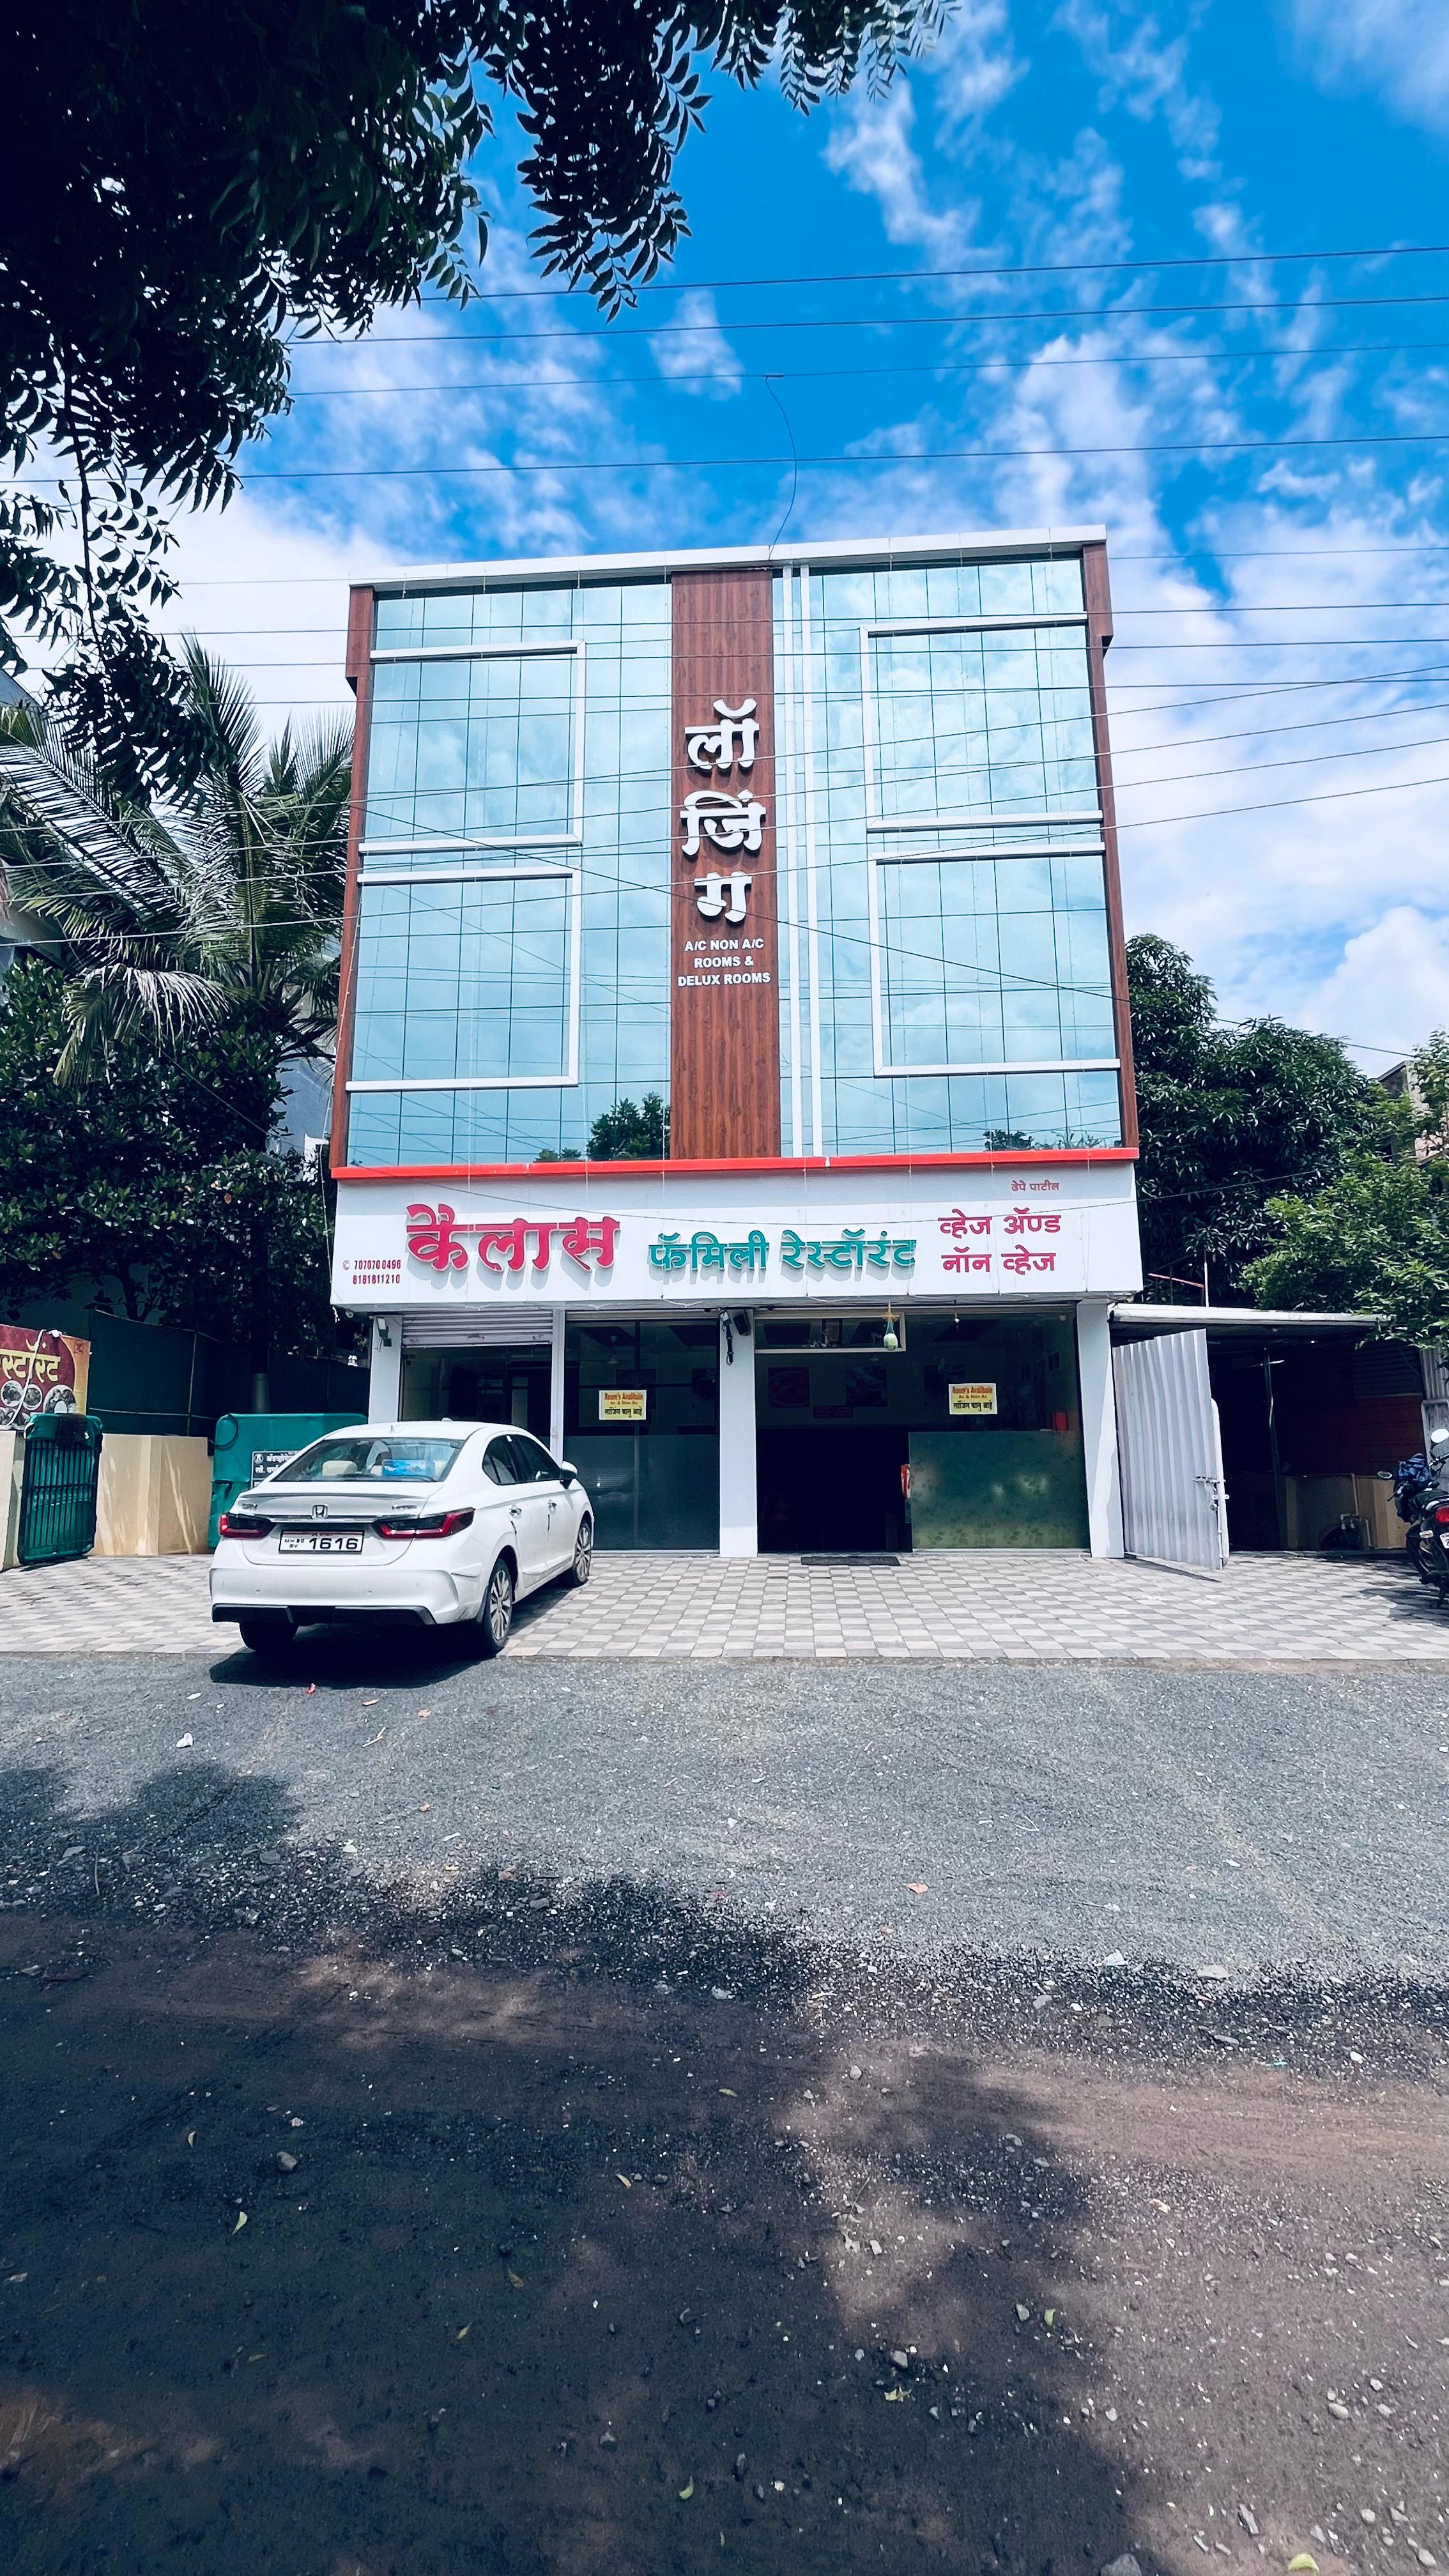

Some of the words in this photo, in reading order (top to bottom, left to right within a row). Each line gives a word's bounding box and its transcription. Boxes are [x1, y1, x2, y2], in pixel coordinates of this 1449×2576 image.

[684, 940, 707, 951] A/C
[710, 939, 738, 950] NON
[742, 938, 764, 949] A/C
[694, 956, 740, 968] ROOMS
[744, 955, 754, 966] &
[677, 974, 721, 986] DELUX
[724, 972, 770, 985] ROOMS
[1029, 1179, 1059, 1192] पाटील
[938, 1208, 992, 1239] व्हेज
[406, 1203, 621, 1272] कैलास
[648, 1229, 770, 1271] फॅमिली
[780, 1228, 917, 1269] रेस्टॉरंट
[941, 1246, 992, 1273] नॉन
[1001, 1245, 1056, 1275] व्हेज
[353, 1274, 401, 1284] 8181811210
[0, 1338, 61, 1384] स्टॉरंट
[309, 1537, 358, 1550] 1616
